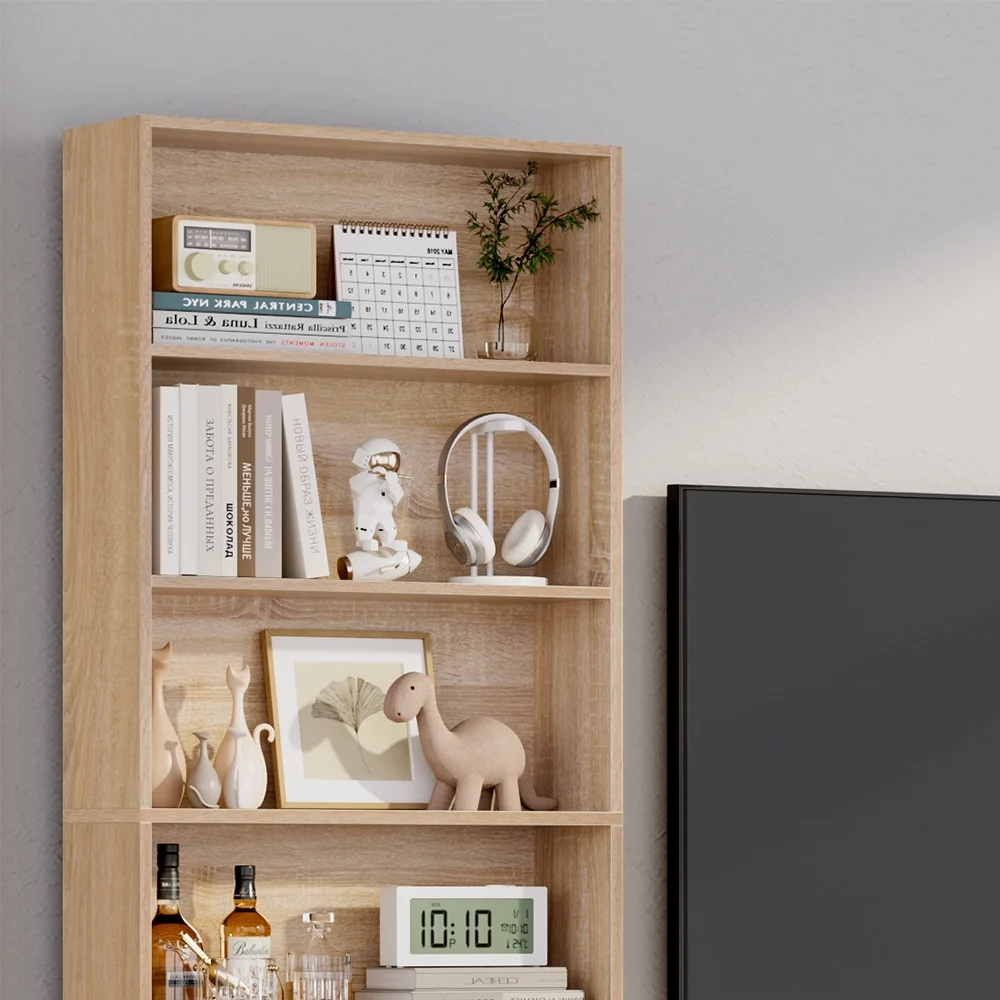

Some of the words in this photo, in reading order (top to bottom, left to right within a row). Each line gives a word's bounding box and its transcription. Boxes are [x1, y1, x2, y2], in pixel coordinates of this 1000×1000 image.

[205, 419, 214, 462] ЗАБОТА
[292, 418, 308, 462] НОВЫЙ
[206, 467, 214, 475] О
[299, 467, 312, 505] ОБРАЗ
[205, 479, 214, 552] ПРЕДАННЫХ
[225, 503, 233, 558] ШОКОЛАД
[305, 509, 319, 554] ЖИЗНИ
[242, 524, 251, 560] ЛУЧШЕ
[421, 910, 491, 948] 10:10
[450, 939, 456, 948] P
[509, 924, 528, 934] 10:10
